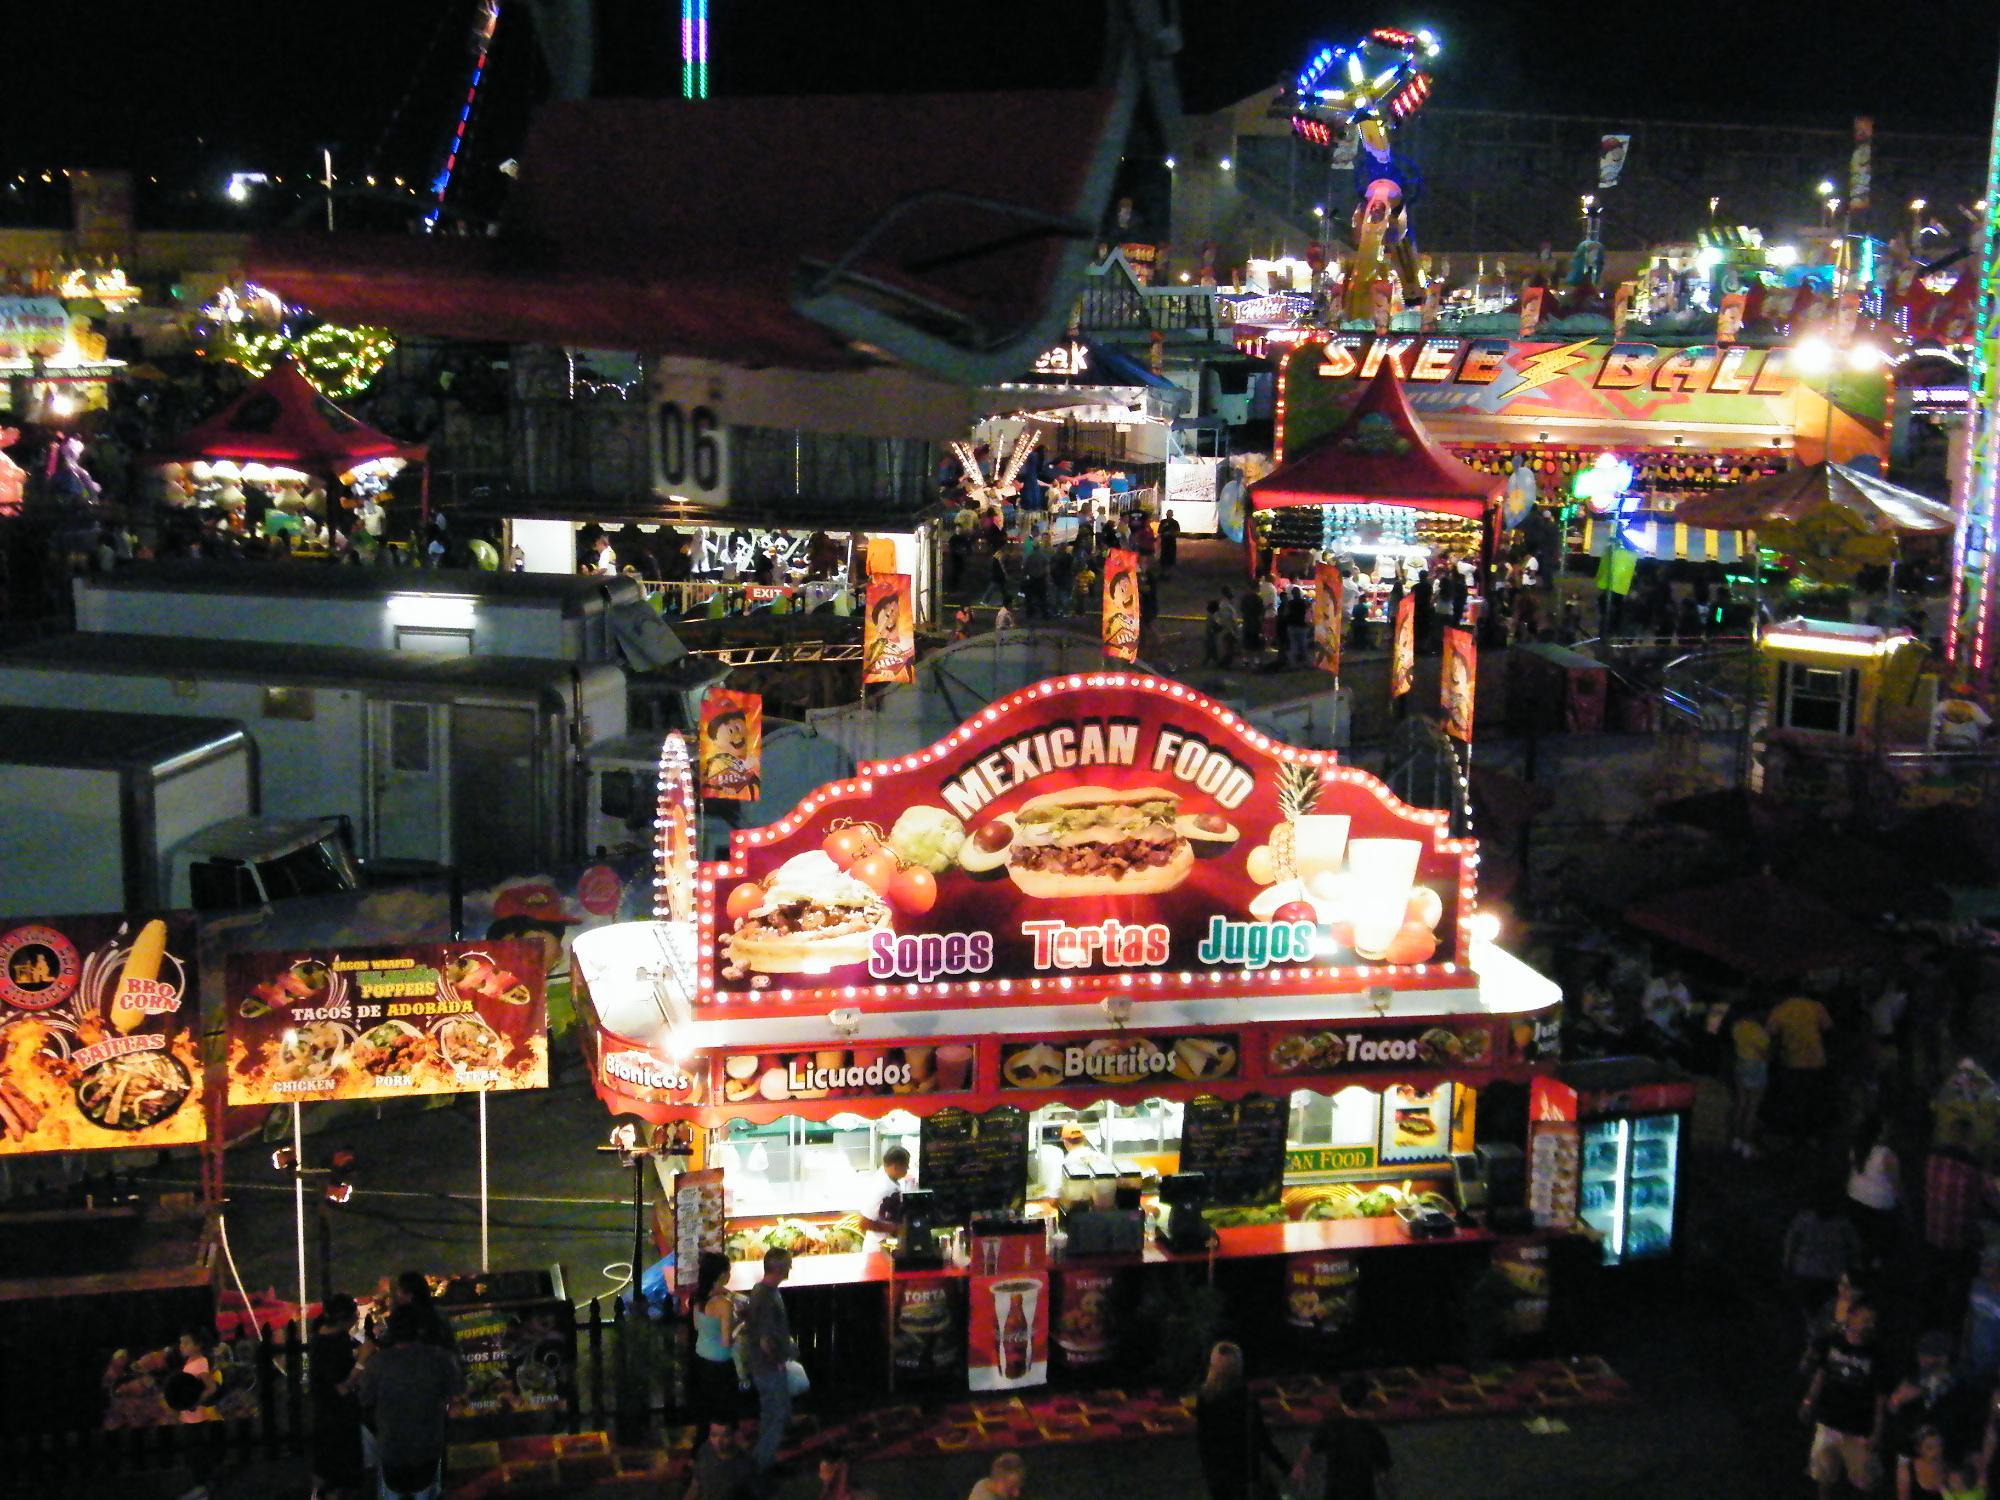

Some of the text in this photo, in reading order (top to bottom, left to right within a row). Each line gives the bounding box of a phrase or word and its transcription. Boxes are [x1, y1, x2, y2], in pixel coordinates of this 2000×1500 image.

[1318, 336, 1512, 385] SKEE
[1592, 342, 1802, 396] BALL
[660, 402, 719, 491] 06
[752, 588, 783, 599] EXIT
[940, 722, 1255, 820] MEXICAN FOOD
[868, 928, 994, 983] Sopes
[1021, 919, 1170, 969] Tortas
[1199, 915, 1318, 969] Jugos
[127, 979, 175, 998] BBQ
[361, 983, 437, 998] POPPERS
[119, 994, 182, 1013] CORN
[291, 1000, 474, 1021] TACOS DE ADOBADA
[1065, 1046, 1177, 1077] Burritos
[1345, 1034, 1417, 1062] Tacos
[375, 1075, 412, 1087] PORK
[606, 1052, 689, 1089] Bionicos
[788, 1057, 911, 1090] Licuados
[272, 1079, 336, 1093] CHICKEN
[1320, 1150, 1367, 1169] FOOD
[904, 1288, 946, 1303] TORTA
